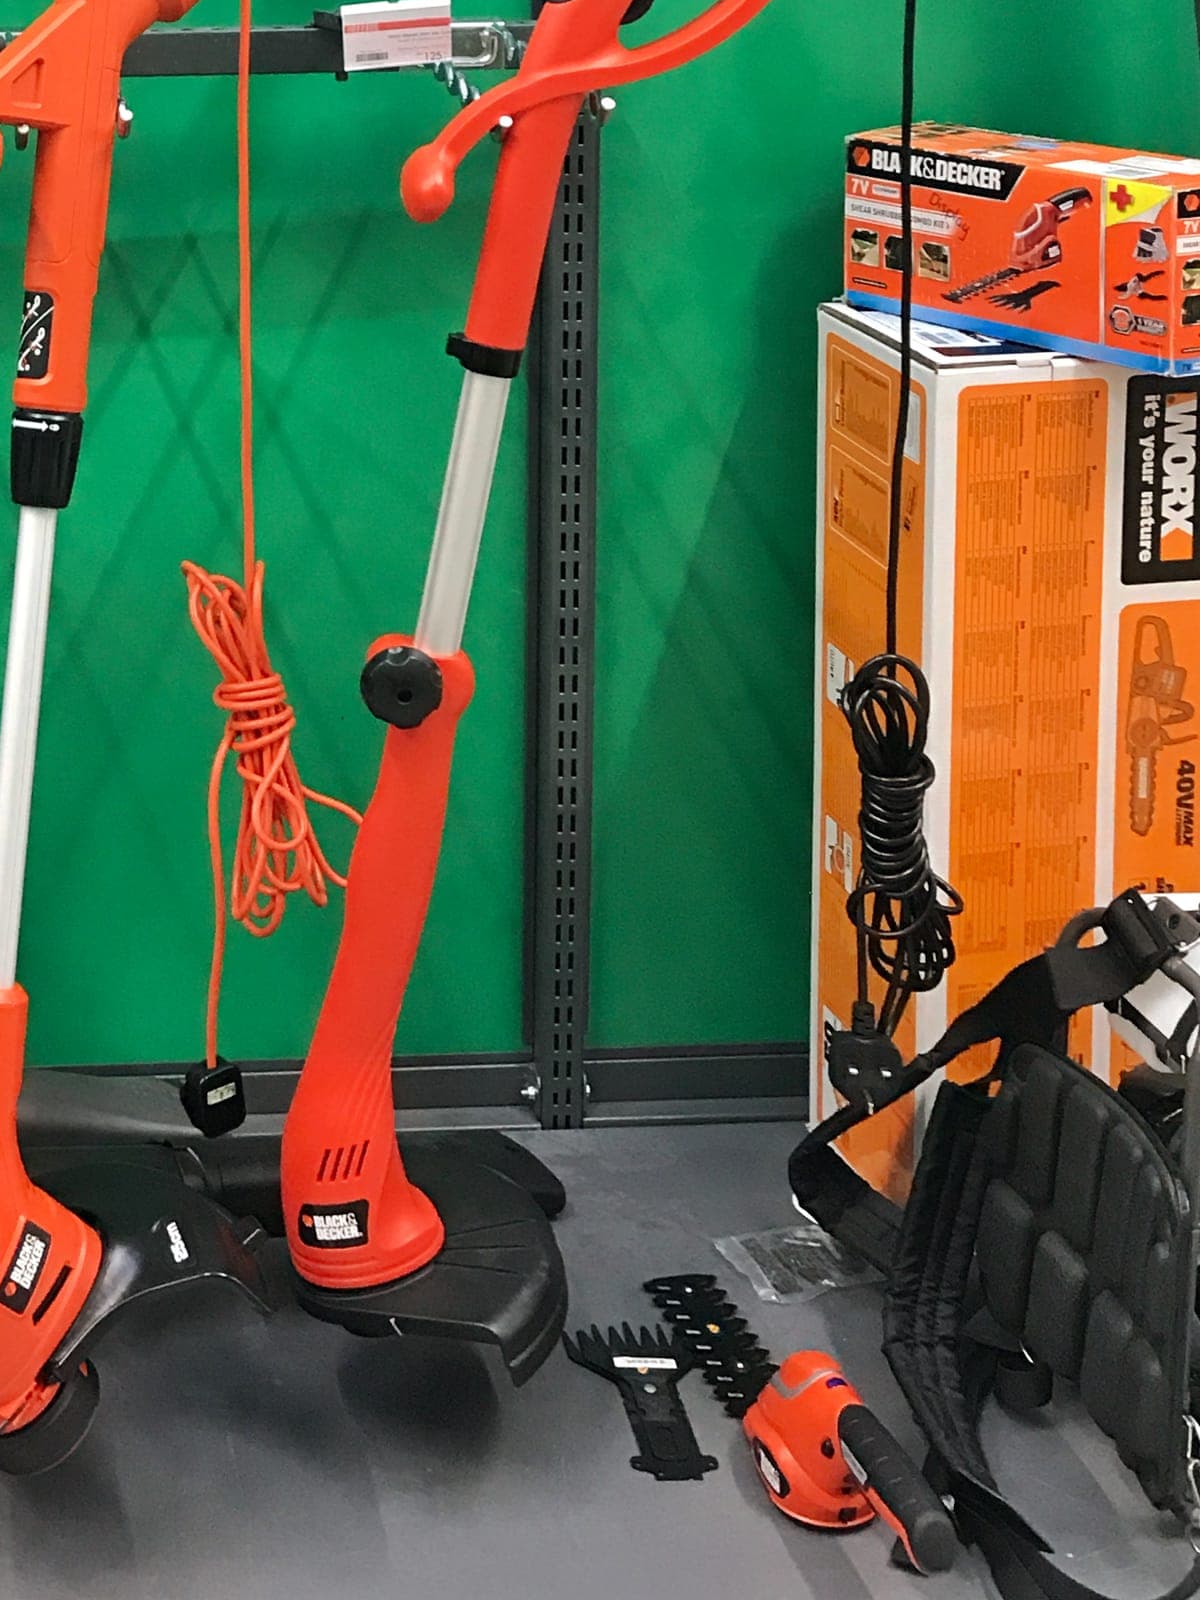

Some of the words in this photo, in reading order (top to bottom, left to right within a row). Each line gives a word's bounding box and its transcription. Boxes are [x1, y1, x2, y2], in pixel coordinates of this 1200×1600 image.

[851, 178, 870, 195] 7V
[871, 149, 1002, 191] BLAK&DECKER
[1143, 394, 1161, 428] it's
[1139, 434, 1155, 485] your
[1161, 393, 1197, 538] WORX
[1138, 491, 1155, 563] nature
